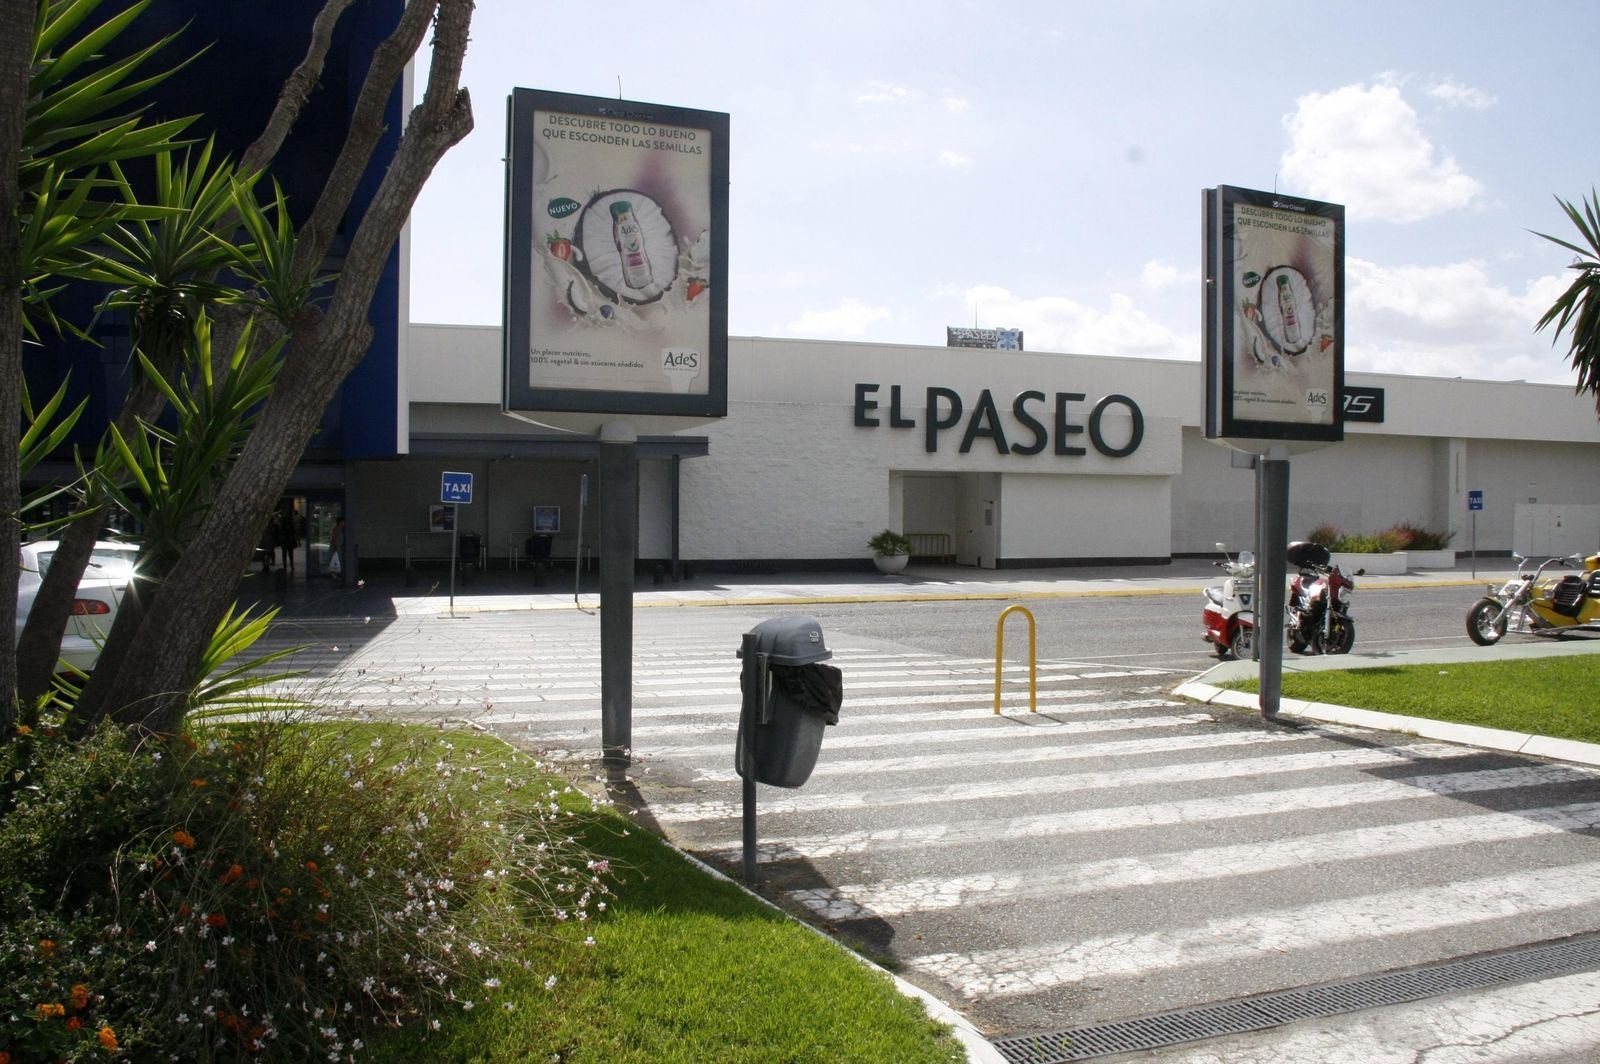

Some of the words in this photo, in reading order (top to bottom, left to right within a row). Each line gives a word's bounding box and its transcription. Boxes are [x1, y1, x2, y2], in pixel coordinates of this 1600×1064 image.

[549, 115, 606, 130] DESCUBRE
[609, 122, 640, 134] TODO
[642, 126, 656, 136] LO
[659, 129, 696, 141] BUENO
[542, 128, 566, 139] QUE
[569, 131, 629, 147] ESCONDEN
[632, 138, 651, 149] LAS
[653, 141, 702, 155] SEMILLAS
[550, 202, 578, 215] NUEVO
[1241, 207, 1274, 218] DESCUBRE
[1275, 213, 1293, 222] TODO
[1294, 216, 1302, 224] LO
[1304, 217, 1326, 227] BUENO
[1238, 217, 1251, 226] QUE
[1253, 219, 1287, 232] ESCONDEN
[1289, 226, 1300, 234] LAS
[542, 348, 561, 356] placer
[664, 352, 698, 368] AdeS
[550, 357, 572, 366] vegetal
[1307, 392, 1327, 404] AdeS
[854, 383, 915, 428] EL
[925, 387, 1145, 458] PASEO
[444, 482, 470, 493] TAXI
